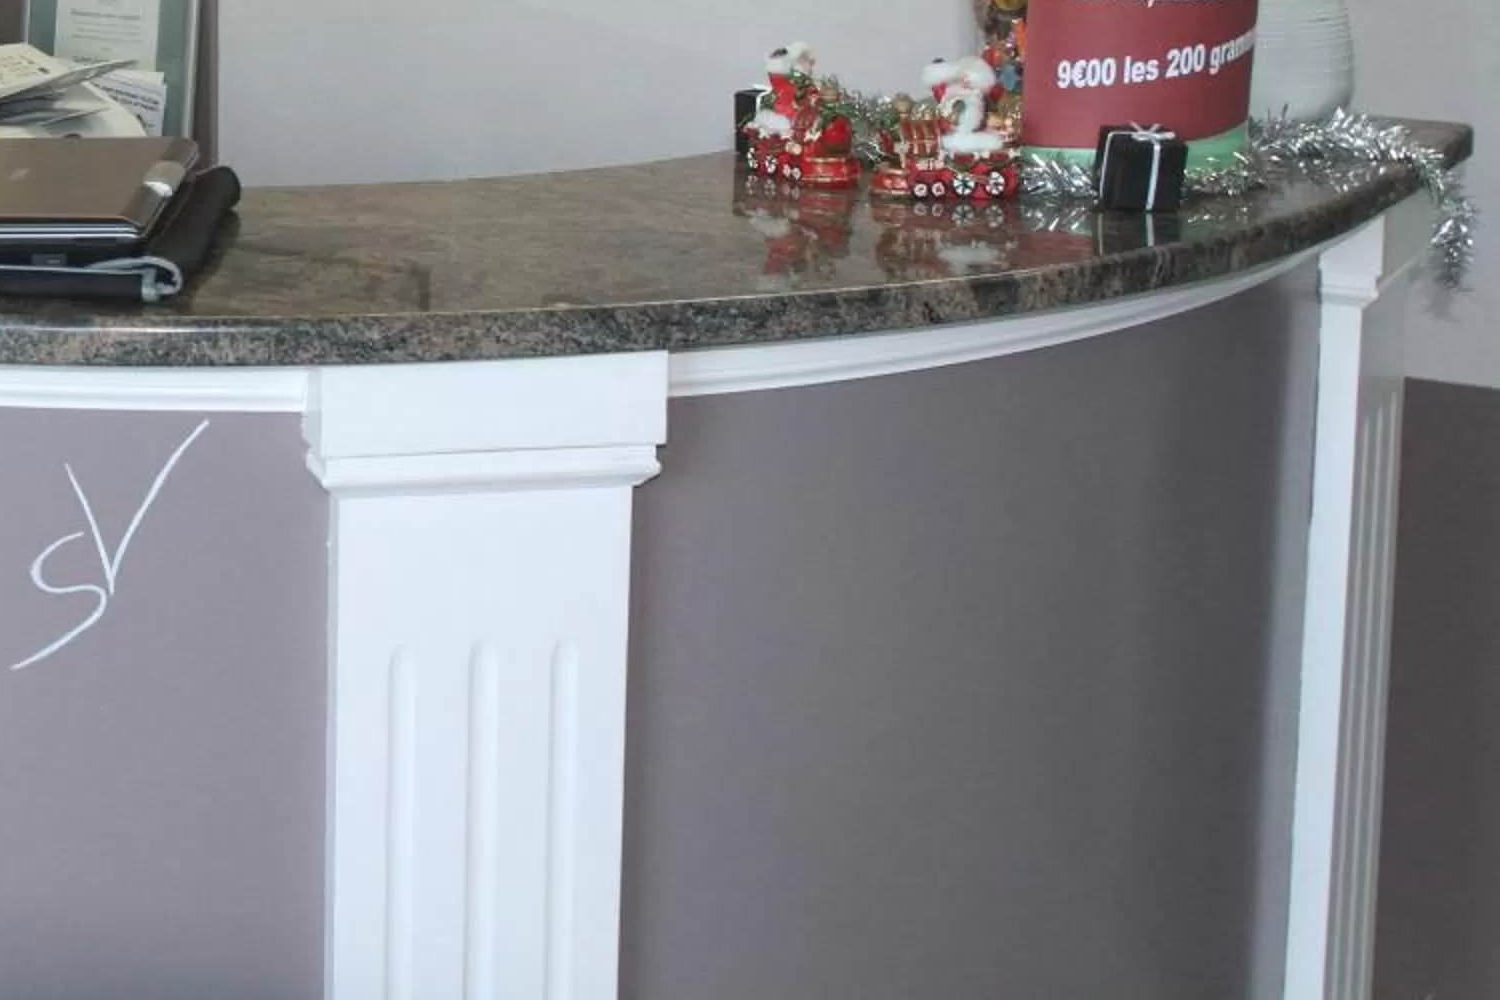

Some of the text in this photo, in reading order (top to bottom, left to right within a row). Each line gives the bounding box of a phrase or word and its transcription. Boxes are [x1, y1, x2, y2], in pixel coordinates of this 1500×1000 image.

[1057, 56, 1116, 89] 9€00
[1123, 55, 1160, 85] les
[1164, 43, 1206, 80] 200
